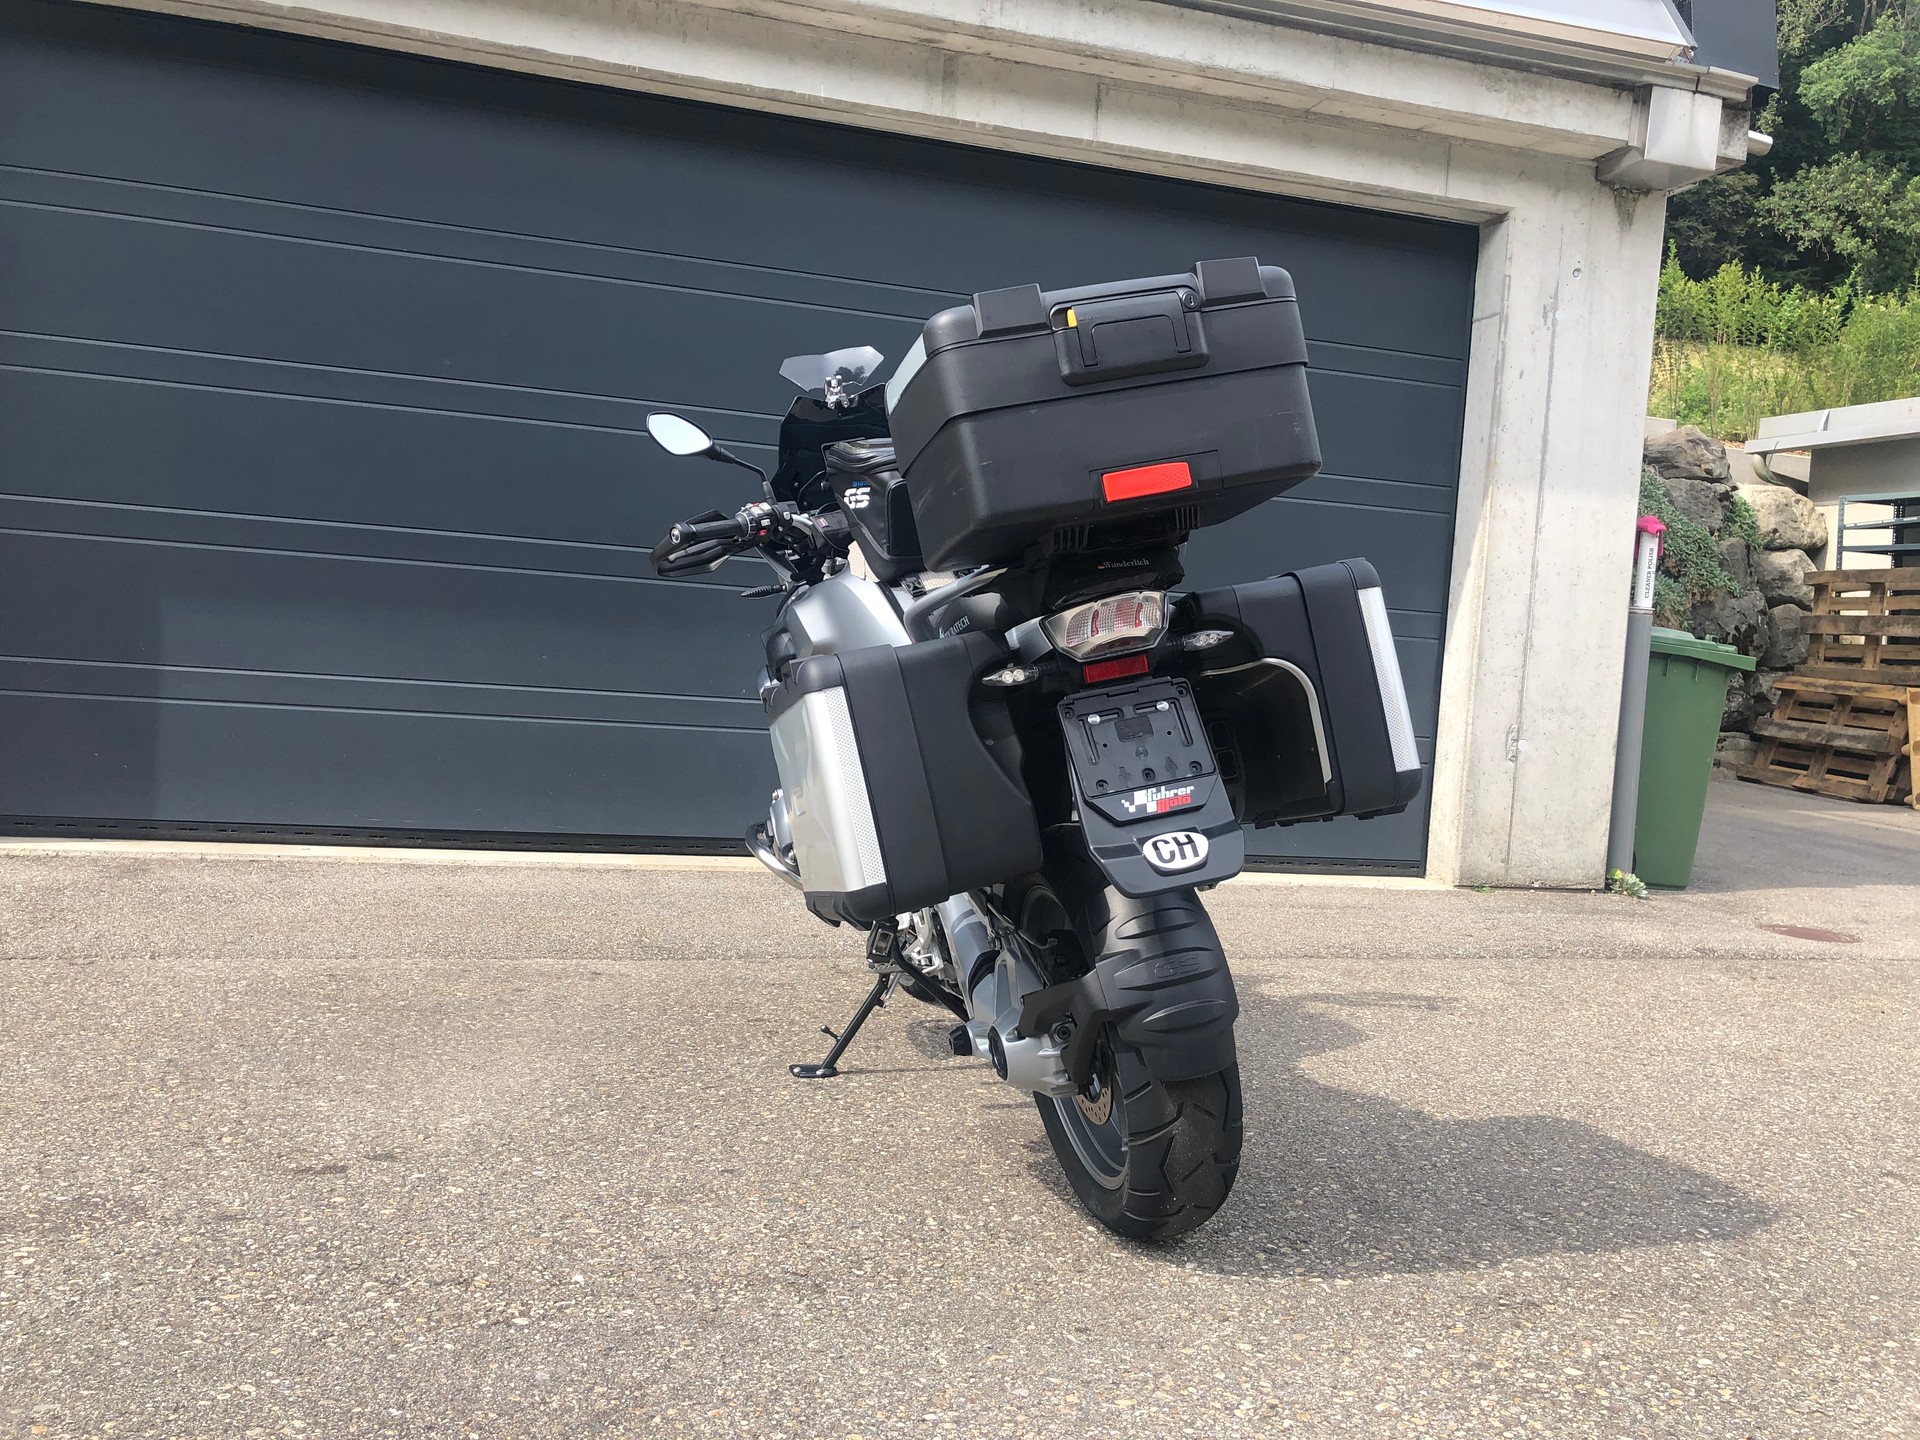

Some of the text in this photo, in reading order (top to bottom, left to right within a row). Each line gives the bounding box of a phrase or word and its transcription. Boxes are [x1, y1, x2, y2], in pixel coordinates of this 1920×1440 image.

[843, 486, 871, 509] GS
[1103, 558, 1150, 569] Wunderlich
[1647, 547, 1655, 570] POLISH
[1644, 570, 1652, 599] CLEANER
[1151, 833, 1200, 864] CH
